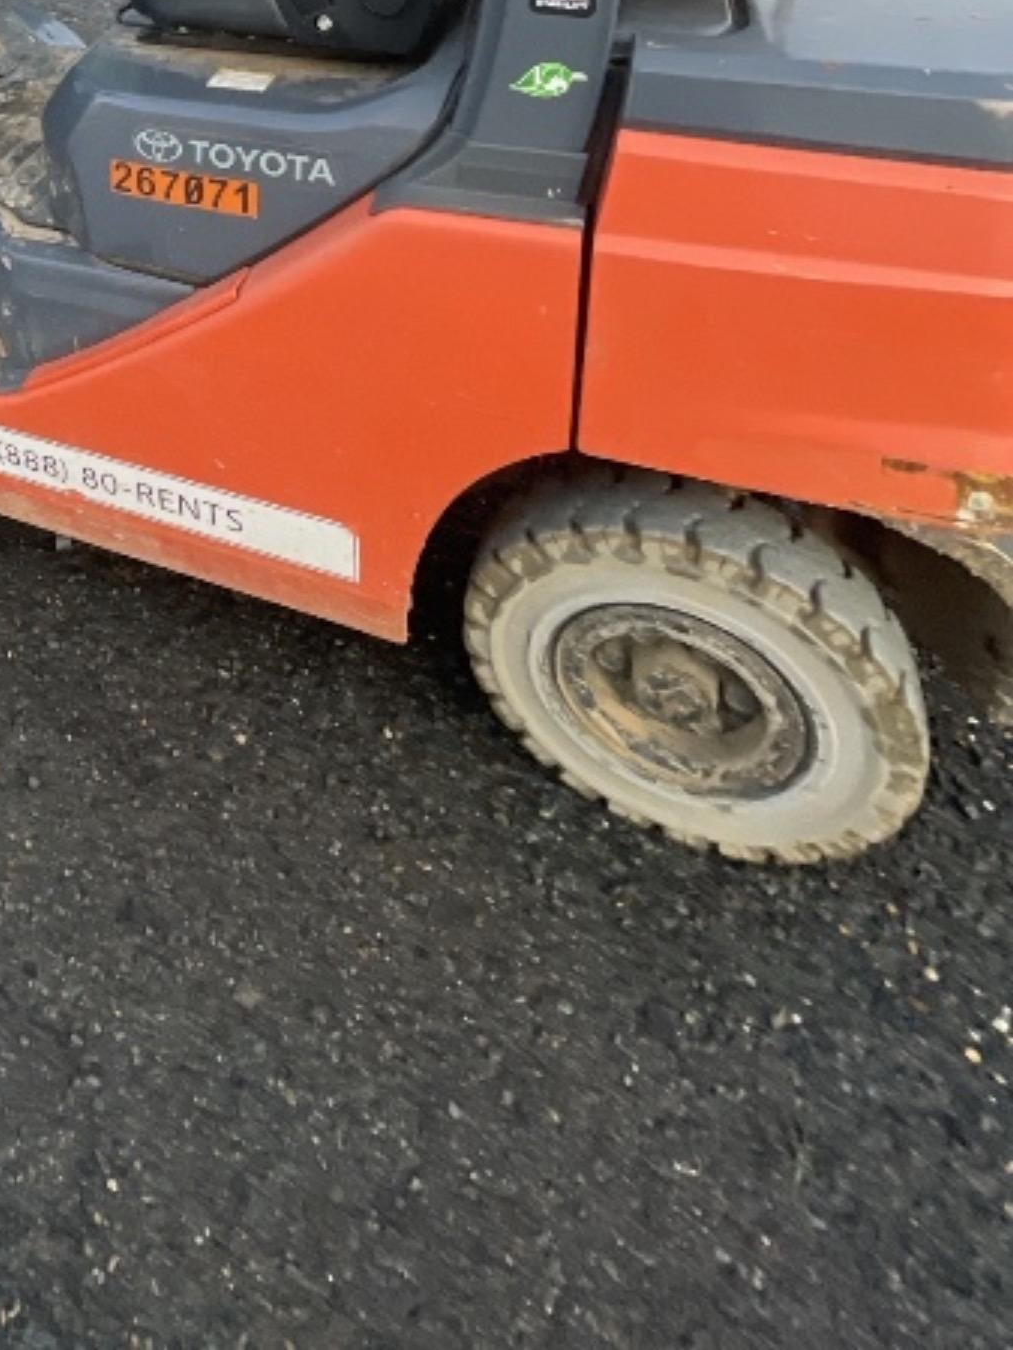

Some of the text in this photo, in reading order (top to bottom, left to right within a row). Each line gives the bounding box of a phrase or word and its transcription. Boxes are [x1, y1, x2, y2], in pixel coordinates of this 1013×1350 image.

[113, 162, 251, 214] 267071
[189, 139, 336, 187] TOYOTA
[81, 465, 245, 534] 80-RENTS
